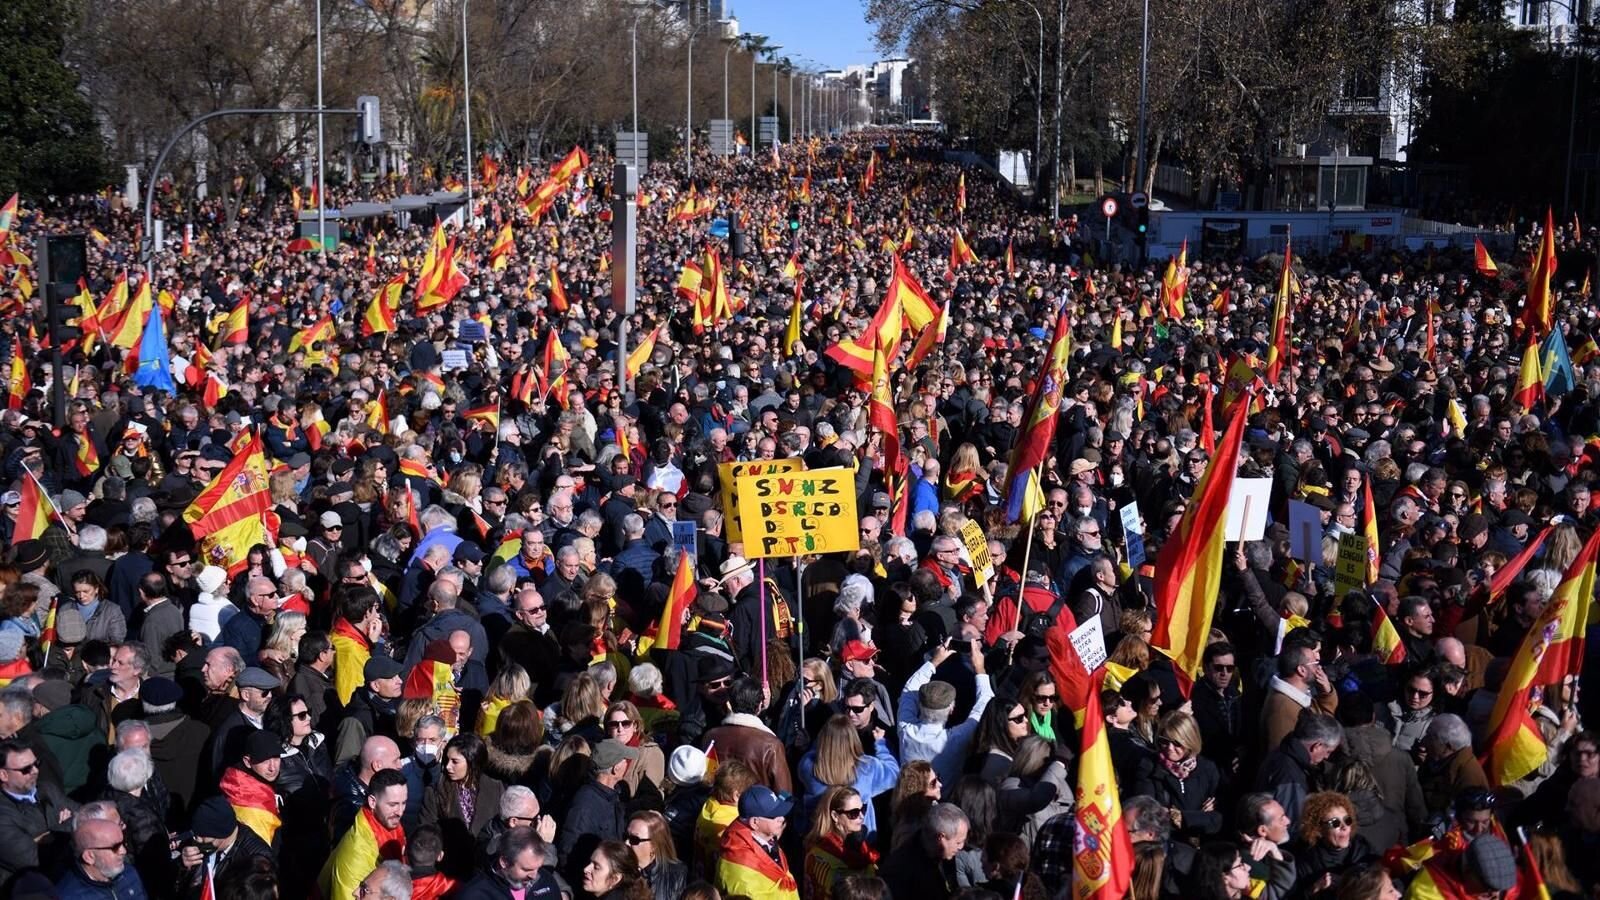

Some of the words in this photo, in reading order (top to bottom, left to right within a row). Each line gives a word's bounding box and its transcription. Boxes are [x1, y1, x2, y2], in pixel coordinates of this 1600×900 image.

[1342, 533, 1354, 547] NO
[1356, 540, 1364, 550] ES
[1346, 563, 1355, 573] ES
[1073, 626, 1096, 646] MERSION
